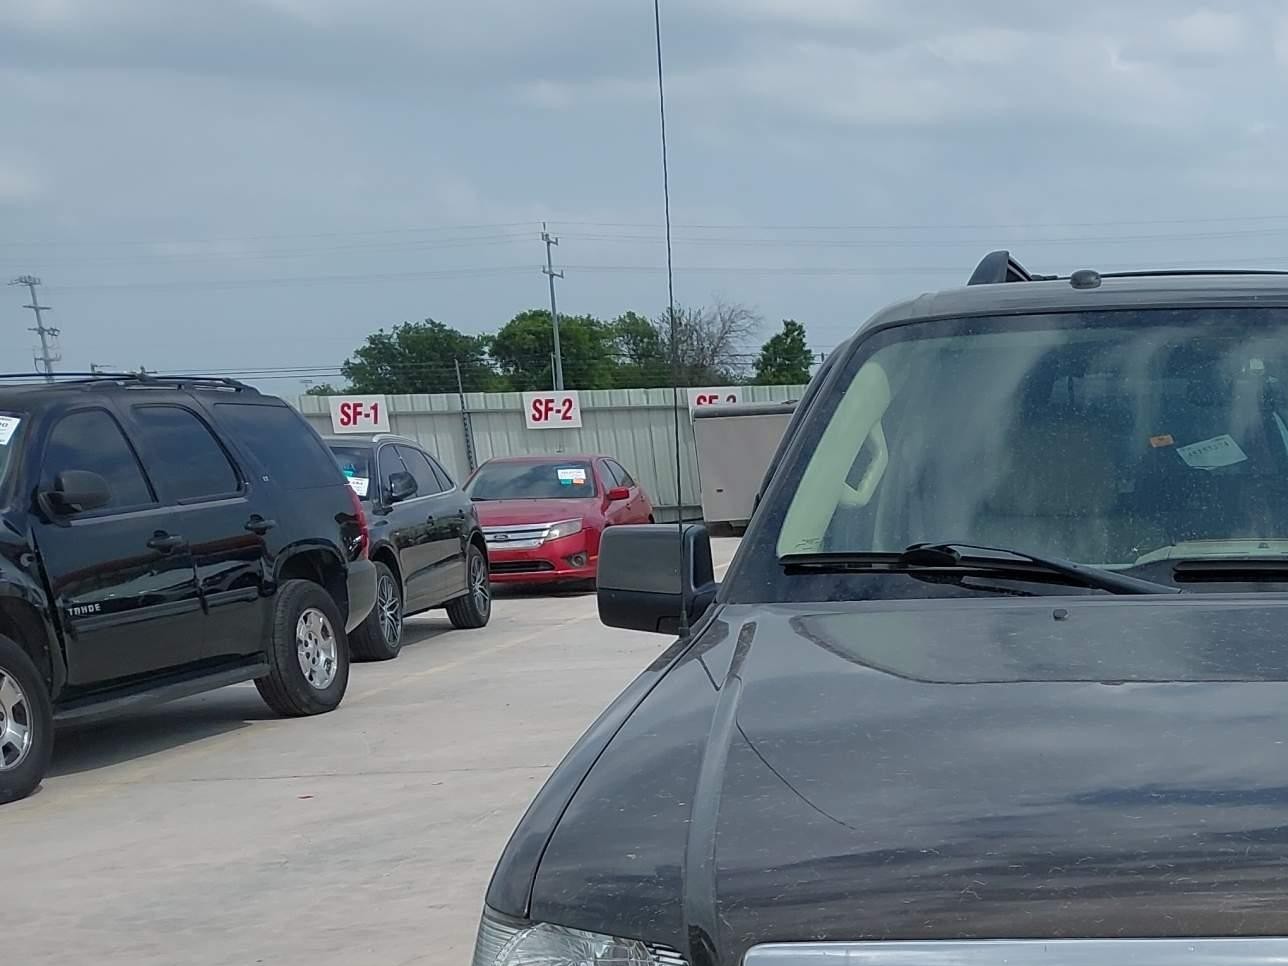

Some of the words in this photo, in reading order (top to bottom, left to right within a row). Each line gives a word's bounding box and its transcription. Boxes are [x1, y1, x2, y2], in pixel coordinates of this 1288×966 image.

[340, 402, 379, 426] SF-1
[531, 398, 573, 422] SF-2
[67, 603, 101, 616] TAHOE
